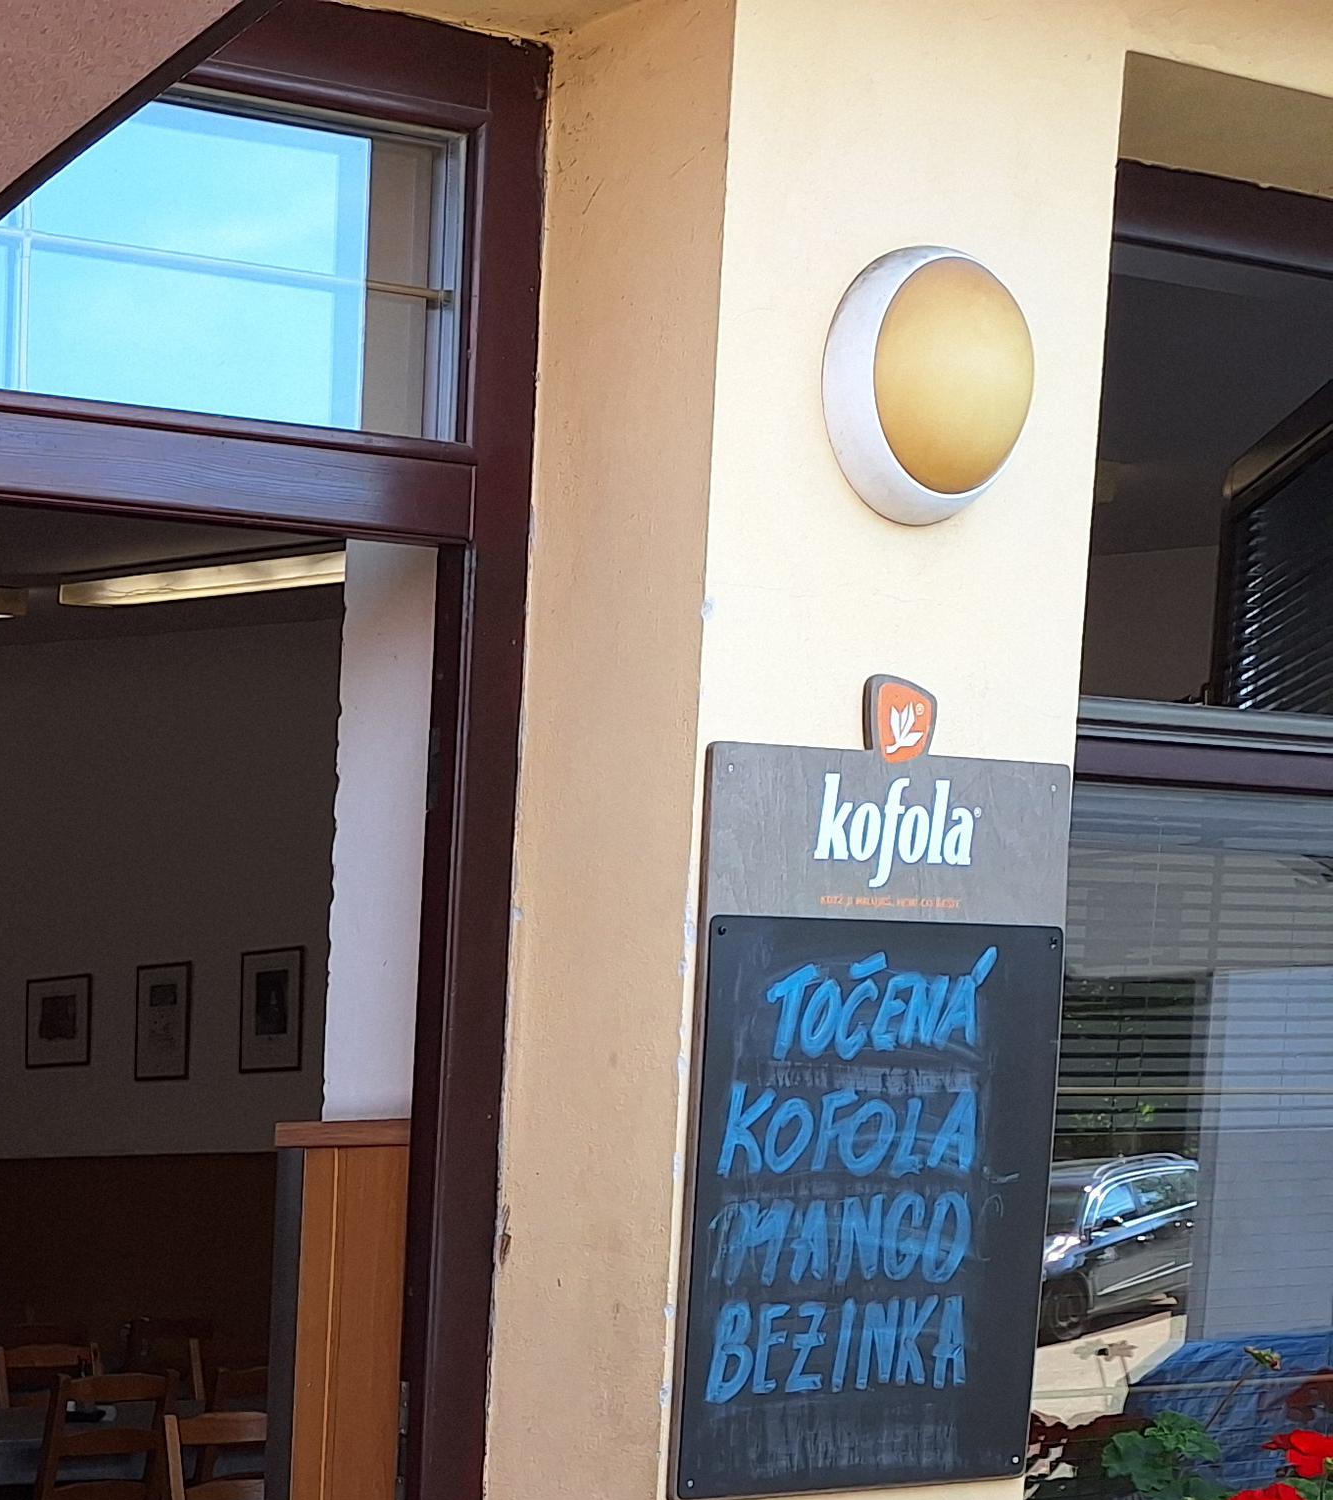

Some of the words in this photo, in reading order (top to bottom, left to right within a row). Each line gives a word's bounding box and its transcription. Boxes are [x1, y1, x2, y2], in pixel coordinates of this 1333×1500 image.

[813, 773, 974, 888] kofola
[767, 946, 998, 1060] TOČENÁ
[716, 1082, 978, 1178] KOFOLA
[721, 1191, 972, 1286] MANGO
[704, 1294, 966, 1405] BEZINKA
